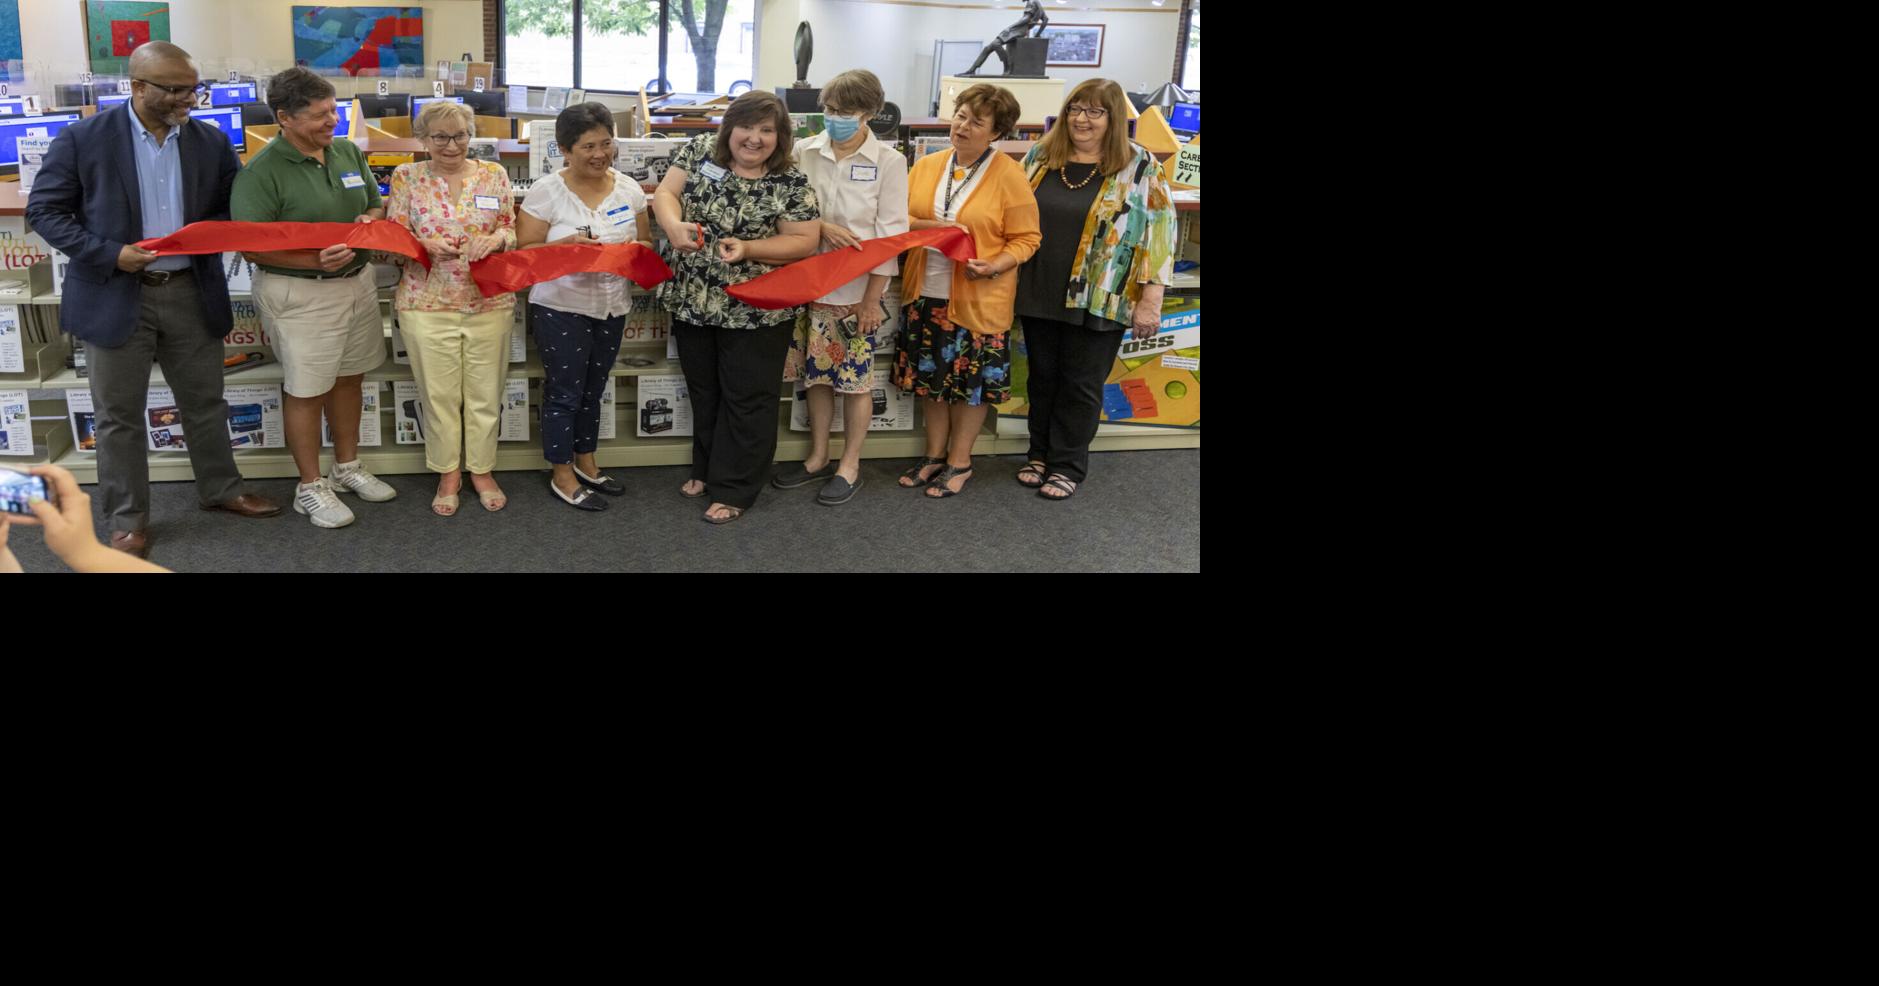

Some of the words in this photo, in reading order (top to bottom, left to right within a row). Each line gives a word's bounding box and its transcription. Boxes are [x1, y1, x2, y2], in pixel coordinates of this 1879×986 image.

[0, 84, 8, 96] 0
[380, 82, 387, 93] 8
[436, 83, 442, 94] 4
[200, 92, 210, 106] 2
[1120, 335, 1174, 354] OSS
